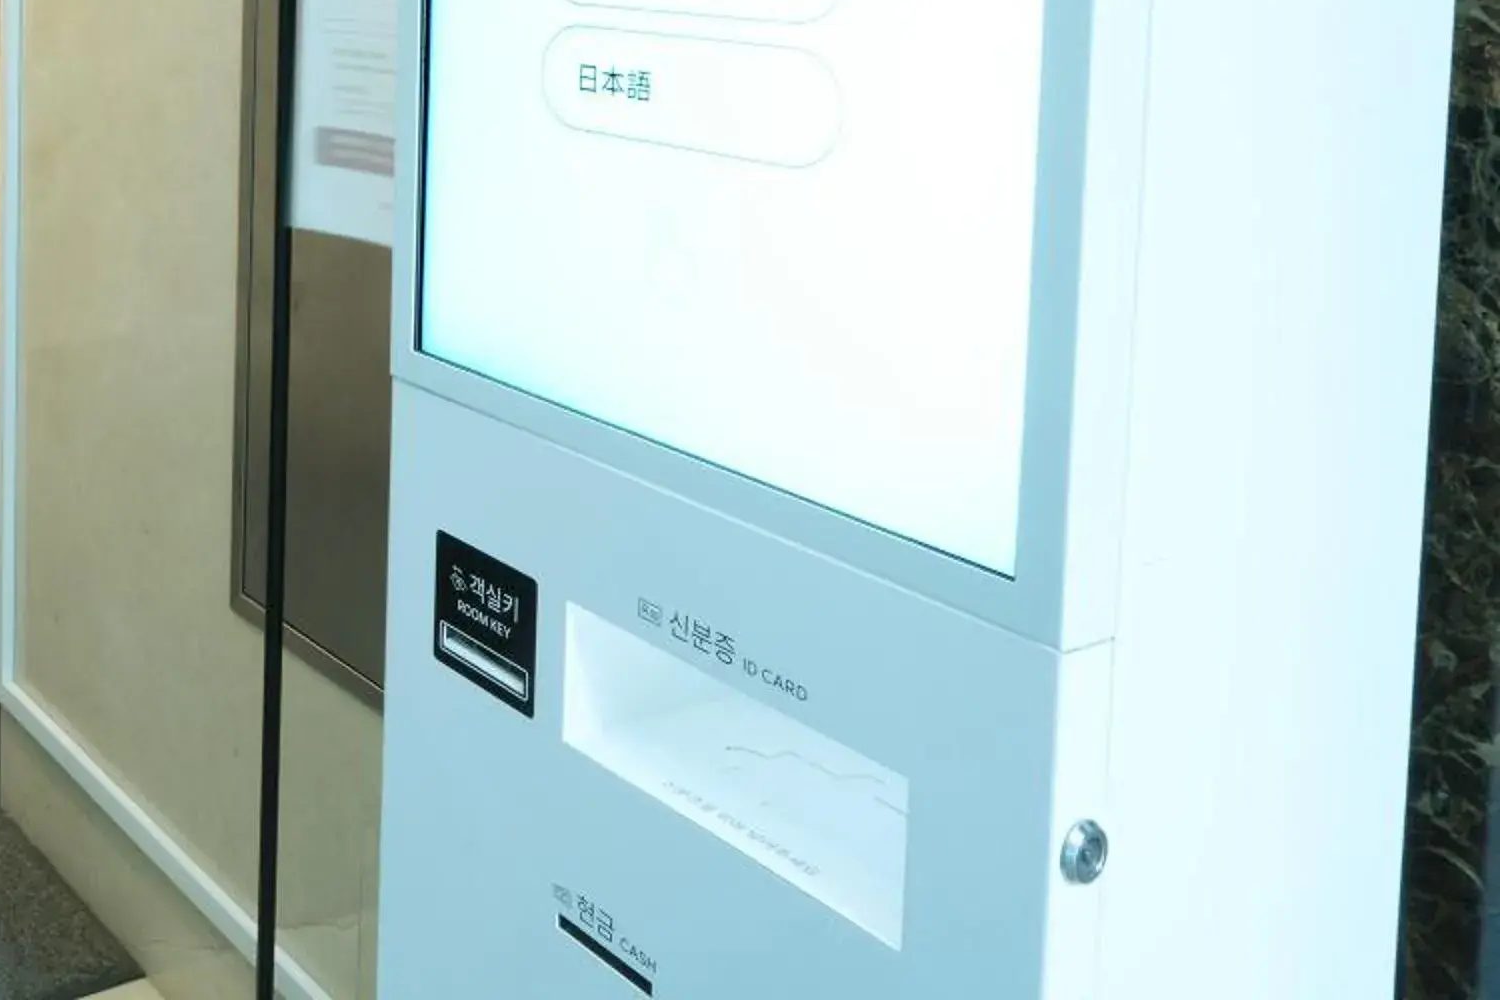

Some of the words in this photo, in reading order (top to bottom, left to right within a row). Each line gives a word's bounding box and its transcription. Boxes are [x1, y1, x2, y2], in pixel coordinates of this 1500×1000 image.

[579, 63, 651, 102] 日本語
[457, 599, 489, 627] ROOM
[489, 618, 511, 639] KEY
[469, 573, 519, 624] 객실키
[669, 610, 737, 665] 신분증
[742, 657, 758, 677] ID
[761, 668, 808, 702] CARD
[577, 893, 615, 943] 현금
[619, 937, 657, 973] CASH
